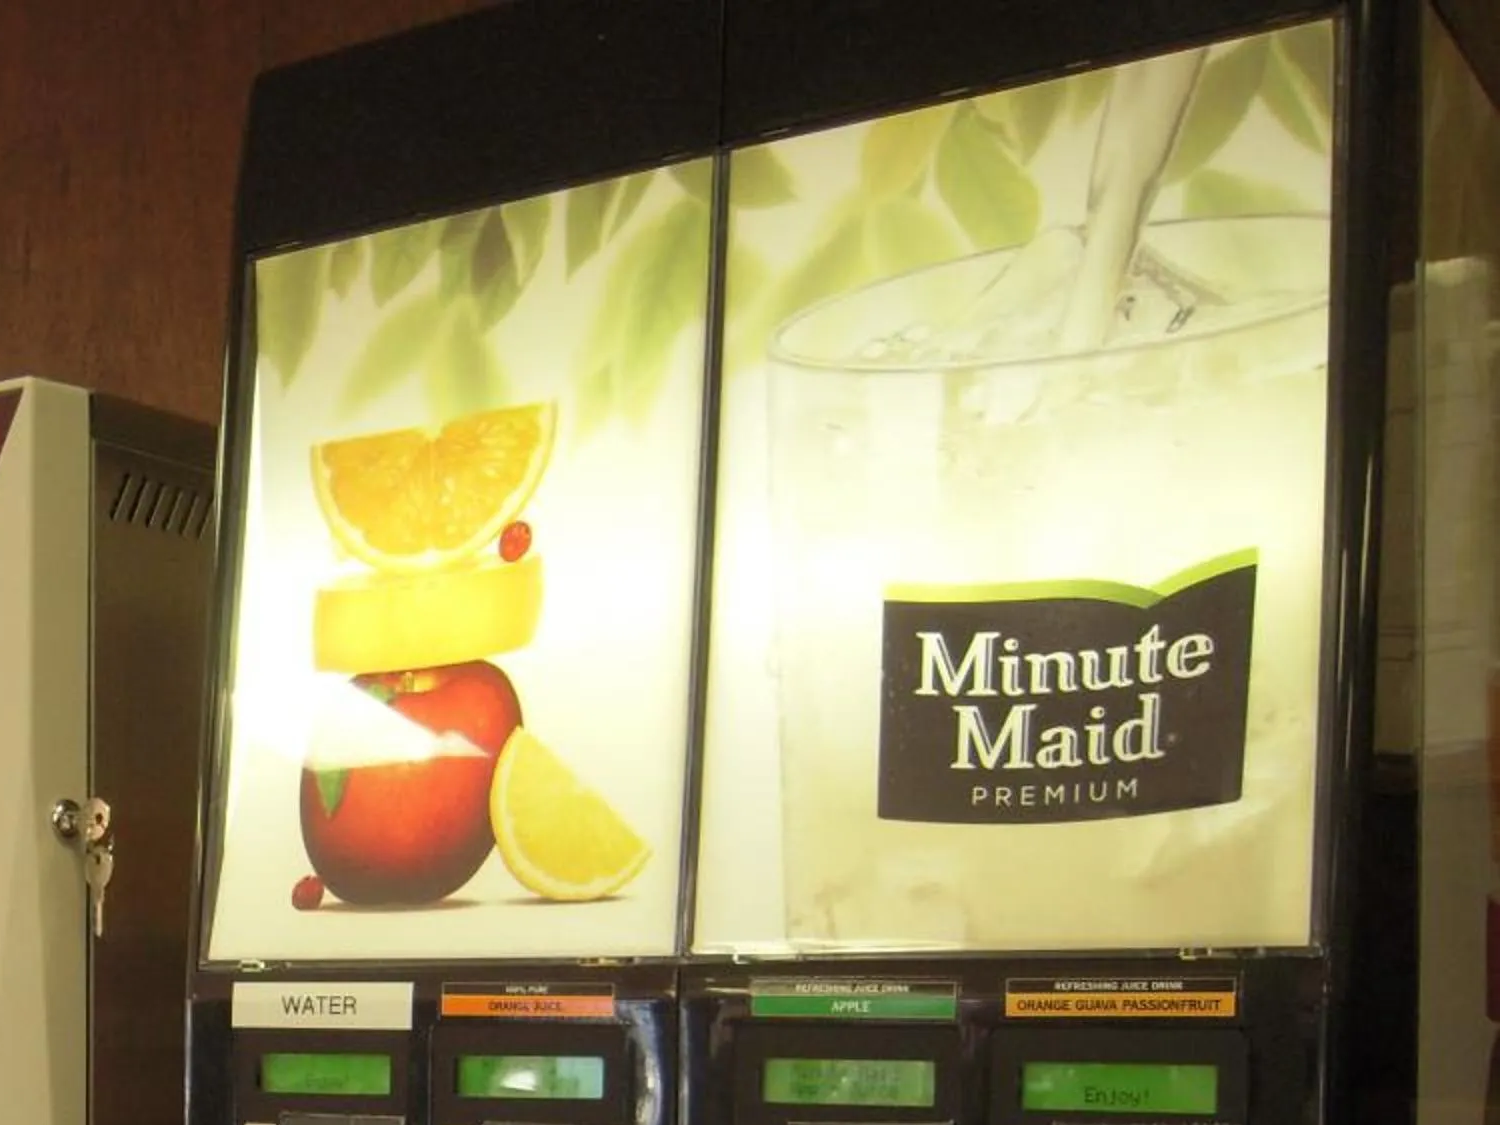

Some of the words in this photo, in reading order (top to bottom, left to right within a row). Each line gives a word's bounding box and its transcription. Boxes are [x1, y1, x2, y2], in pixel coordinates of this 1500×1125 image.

[915, 623, 1215, 697] Minute
[950, 692, 1166, 769] Maid
[972, 777, 1139, 807] PREMIUM
[1120, 981, 1149, 991] JUICE
[1152, 981, 1184, 991] DRINK
[281, 995, 358, 1016] WATER
[487, 1000, 529, 1012] ORANGE
[532, 1000, 564, 1012] JUICE
[831, 1000, 872, 1013] APPLE
[1016, 999, 1072, 1012] ORANGE
[1075, 999, 1118, 1012] GUAVA
[1122, 999, 1222, 1012] PASSIONFRUIT
[1083, 1086, 1151, 1108] Enjoy!
